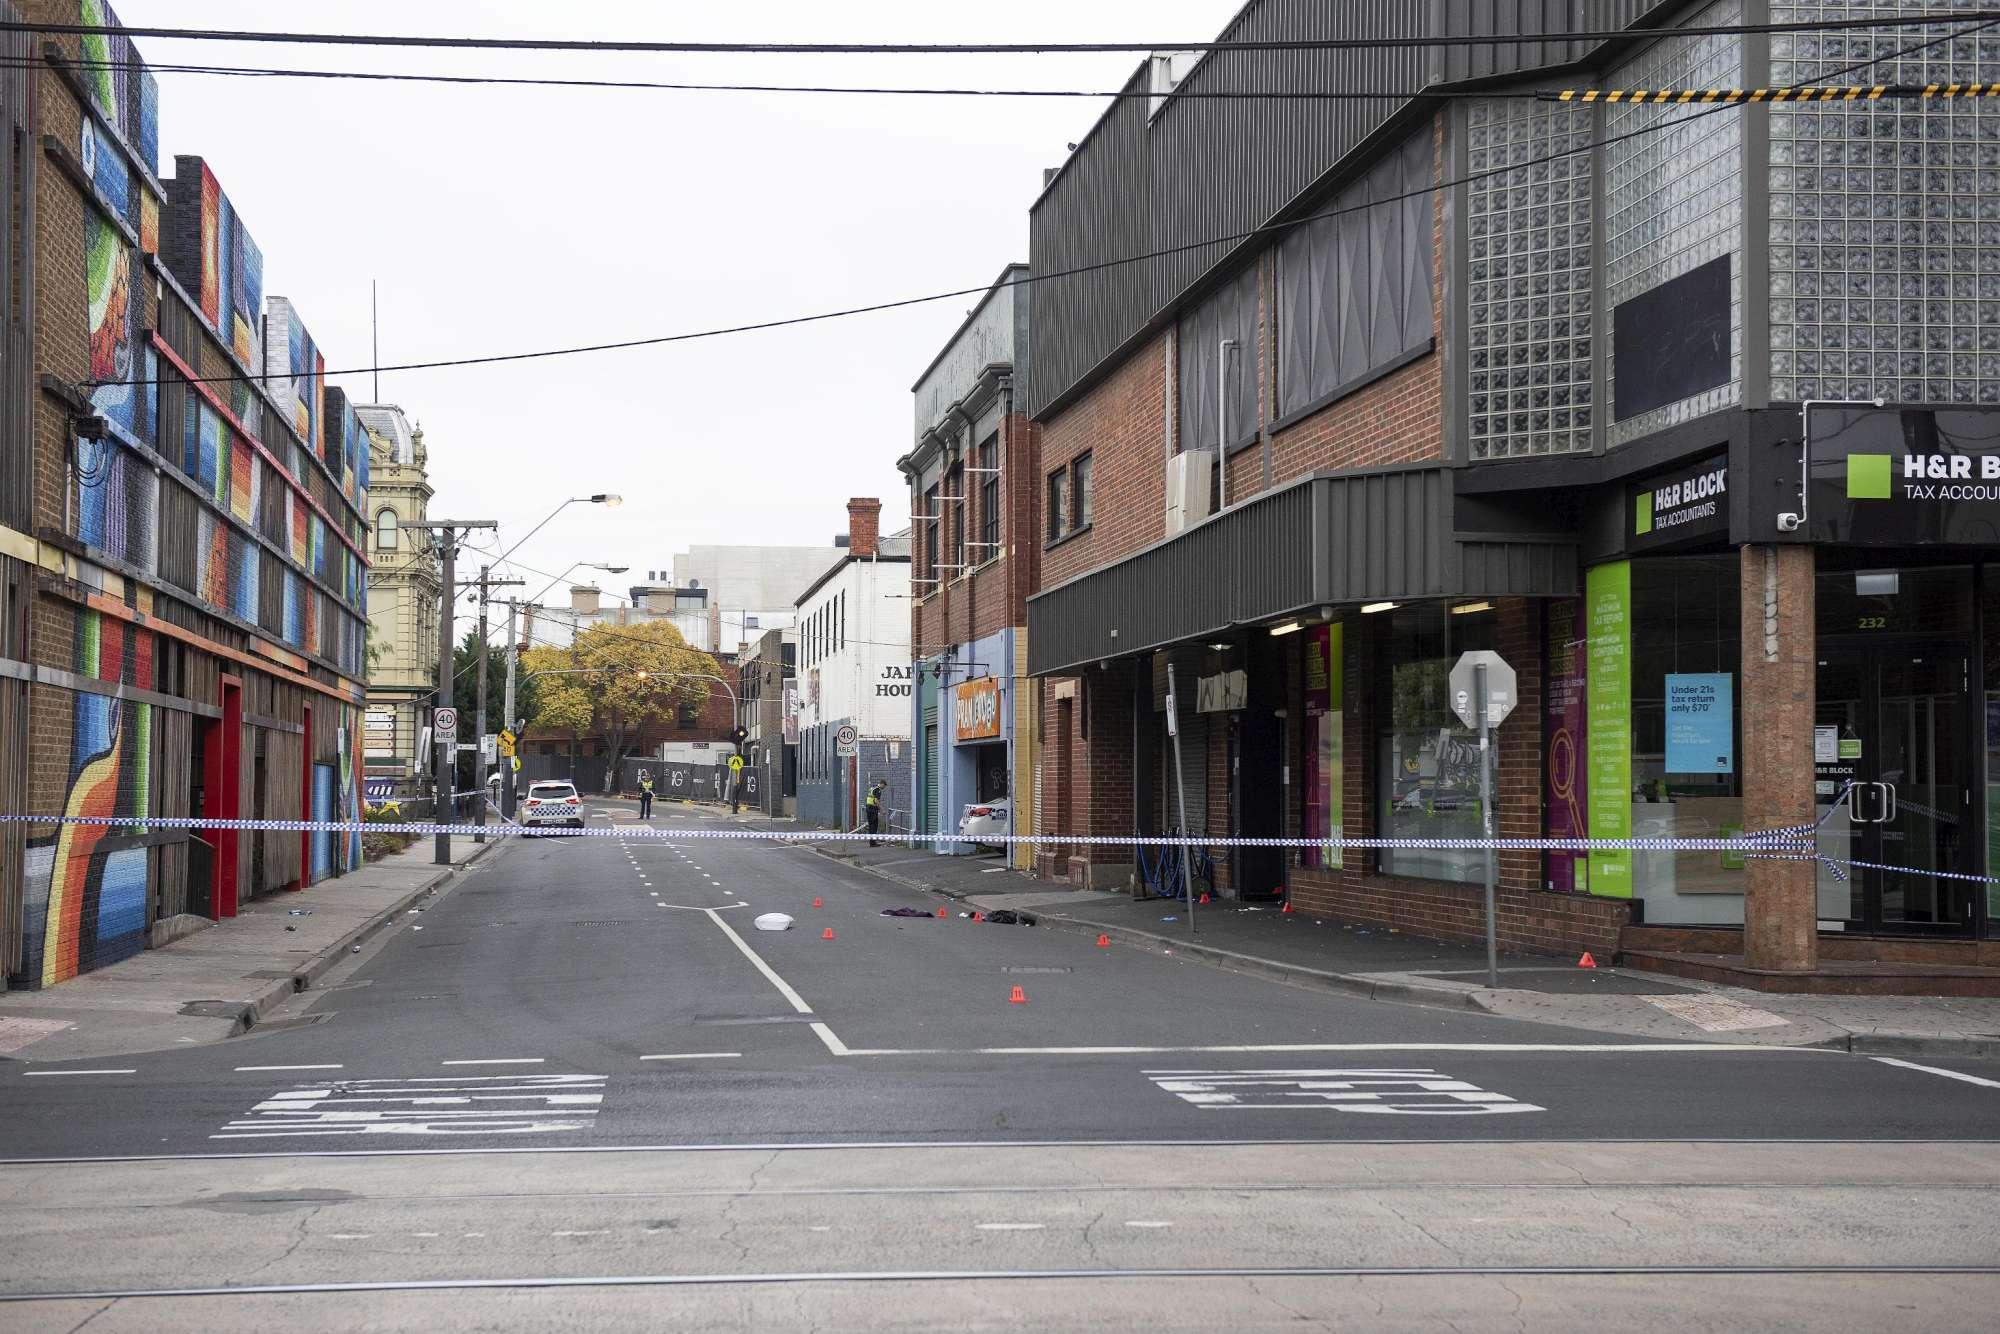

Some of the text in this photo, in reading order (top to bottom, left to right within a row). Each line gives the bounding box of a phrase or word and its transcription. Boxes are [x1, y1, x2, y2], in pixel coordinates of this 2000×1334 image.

[1904, 454, 1971, 479] H&R
[1655, 468, 1726, 511] H&R BLOCK
[1904, 485, 2000, 500] TAX ACCOU
[1656, 501, 1715, 530] TAX ACCOUNTANTS
[1858, 617, 1886, 629] 232
[1671, 685, 1715, 694] Under 21s
[1671, 695, 1715, 703] tax return
[1671, 704, 1691, 713] only
[438, 714, 453, 724] 40
[435, 731, 456, 739] AREA
[840, 730, 853, 740] 40
